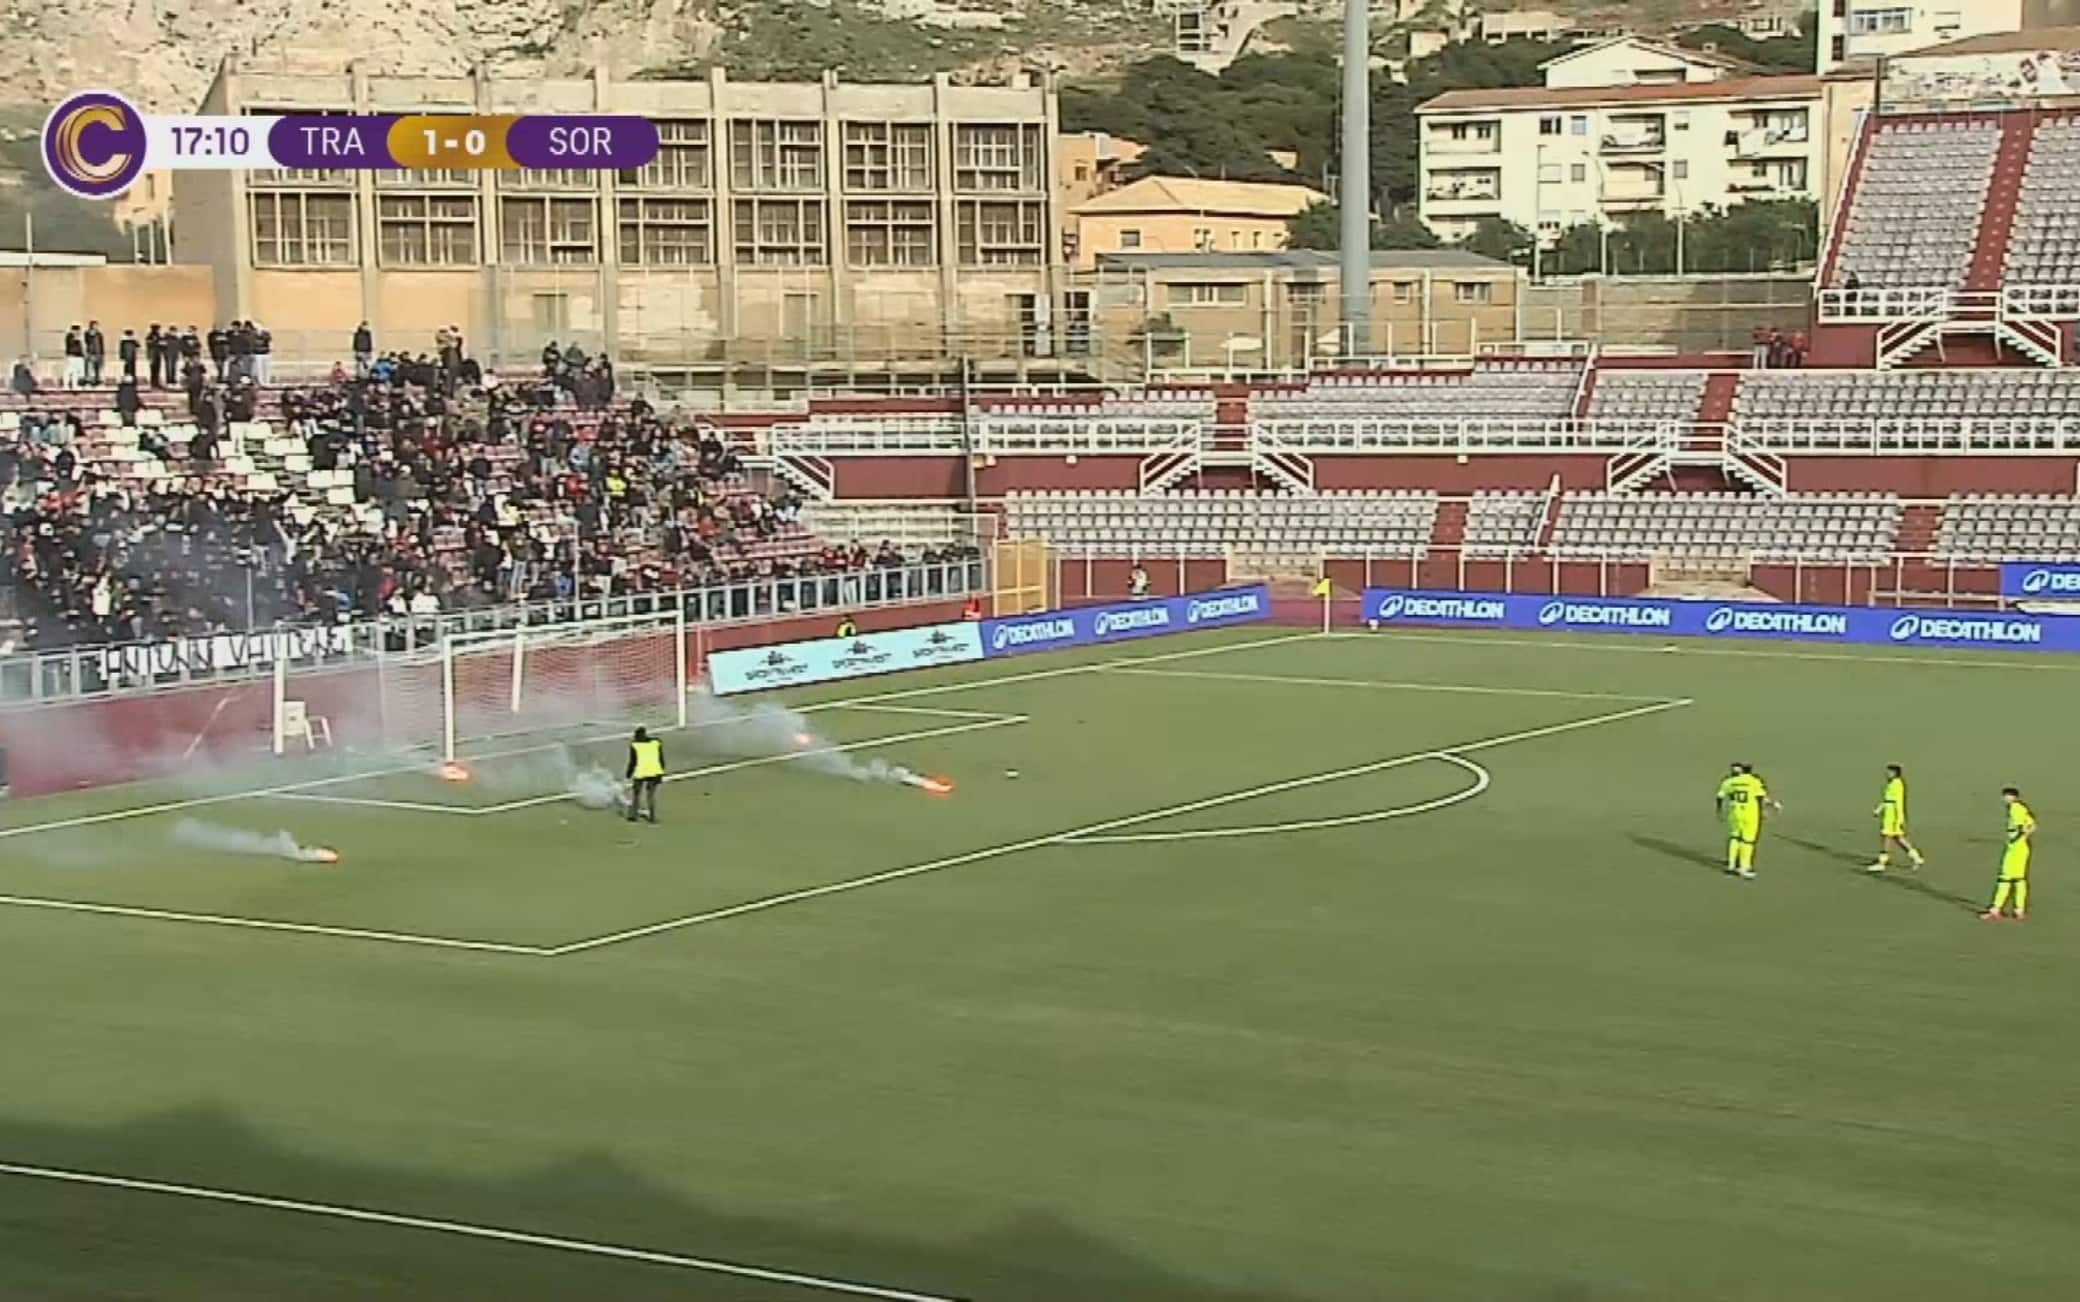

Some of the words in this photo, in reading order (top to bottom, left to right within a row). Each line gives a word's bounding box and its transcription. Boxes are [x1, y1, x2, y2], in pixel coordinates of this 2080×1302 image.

[1404, 599, 1504, 618] DECATHLON
[1566, 605, 1670, 626] DECATHLON
[1734, 611, 1846, 634] DECATHLON
[1921, 619, 2041, 642] DECATHLON
